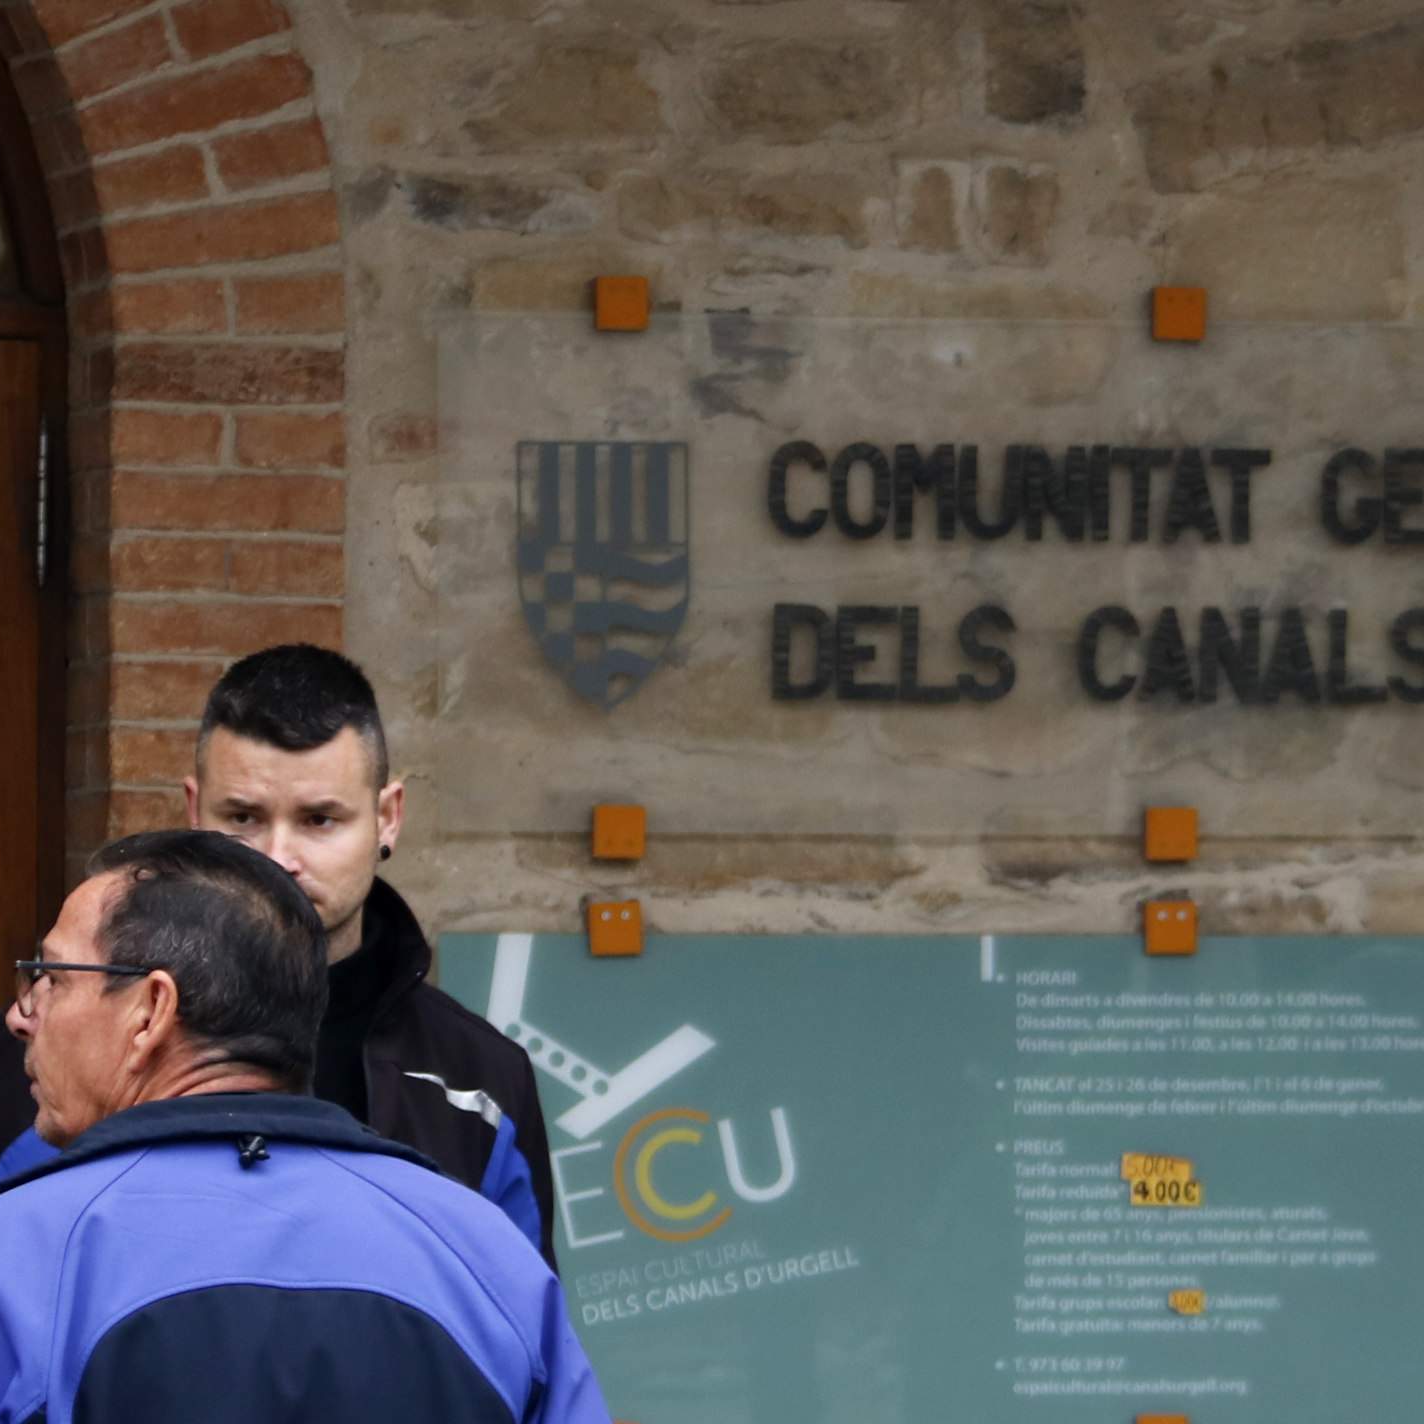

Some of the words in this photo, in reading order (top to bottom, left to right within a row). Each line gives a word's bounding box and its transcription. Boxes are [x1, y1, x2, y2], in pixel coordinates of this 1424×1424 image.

[768, 440, 1271, 546] COMUNITAT
[771, 602, 1018, 701] DELS
[1015, 969, 1078, 986] HORARI
[1016, 992, 1037, 1009] De
[1040, 992, 1101, 1009] dimarts
[1115, 992, 1191, 1009] divendres
[1194, 992, 1214, 1009] de
[1096, 1014, 1181, 1034] diumenges
[1193, 1014, 1244, 1031] festius
[1247, 1014, 1266, 1031] de
[1016, 1036, 1066, 1052] Visites
[1068, 1036, 1128, 1056] guiades
[1144, 1036, 1166, 1052] les
[1231, 1036, 1253, 1052] les
[1014, 1077, 1075, 1093] TANCAT
[1149, 1077, 1169, 1093] de
[1066, 1098, 1144, 1118] diumenge
[1148, 1098, 1168, 1115] de
[1171, 1098, 1217, 1115] febrer
[1280, 1098, 1358, 1118] diumenge
[1013, 1139, 1064, 1156] PREUS
[551, 1105, 795, 1249] ECU
[1016, 1162, 1056, 1178] Tarifa
[1016, 1183, 1056, 1201] Tarifa
[1024, 1206, 1076, 1225] majors
[1079, 1206, 1100, 1221] de
[1023, 1228, 1063, 1247] joves
[1067, 1228, 1109, 1243] entre
[1197, 1228, 1251, 1243] titulars
[1254, 1228, 1274, 1243] de
[1277, 1228, 1329, 1243] Carnet
[1024, 1251, 1073, 1266] carnet
[1168, 1251, 1217, 1266] carnet
[1220, 1249, 1279, 1266] familiar
[577, 1266, 639, 1298] ESPAI
[642, 1240, 768, 1283] CULTURAL
[582, 1297, 640, 1326] DELS
[645, 1272, 739, 1312] CANALS
[744, 1246, 860, 1290] D'URGELL
[1024, 1272, 1044, 1288] de
[1081, 1272, 1102, 1288] de
[1015, 1294, 1055, 1311] Tarifa
[1059, 1296, 1103, 1315] grups
[1015, 1316, 1055, 1332] Tarifa
[1127, 1316, 1185, 1332] menors
